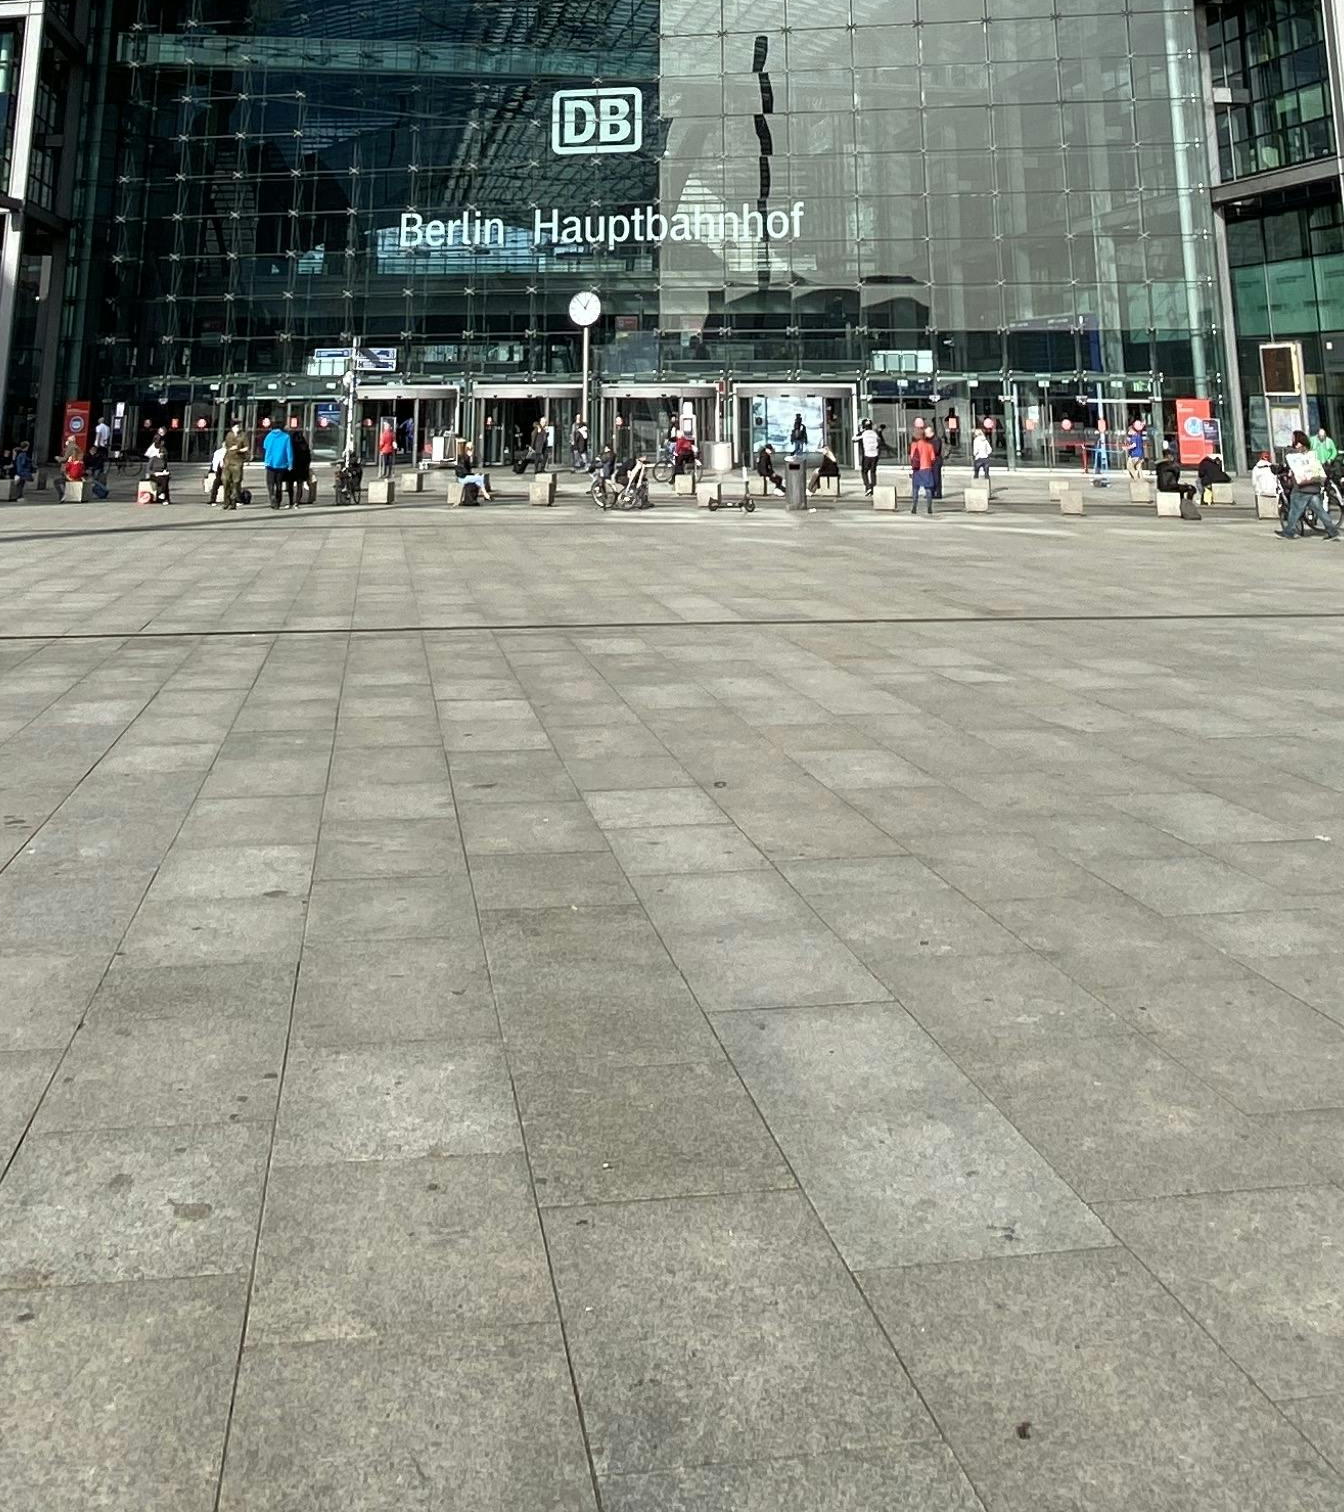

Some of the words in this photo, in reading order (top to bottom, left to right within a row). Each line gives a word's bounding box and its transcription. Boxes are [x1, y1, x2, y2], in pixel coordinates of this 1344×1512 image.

[563, 98, 632, 144] DB
[399, 210, 505, 248] Berlin
[533, 201, 805, 251] Hauptbahnhof
